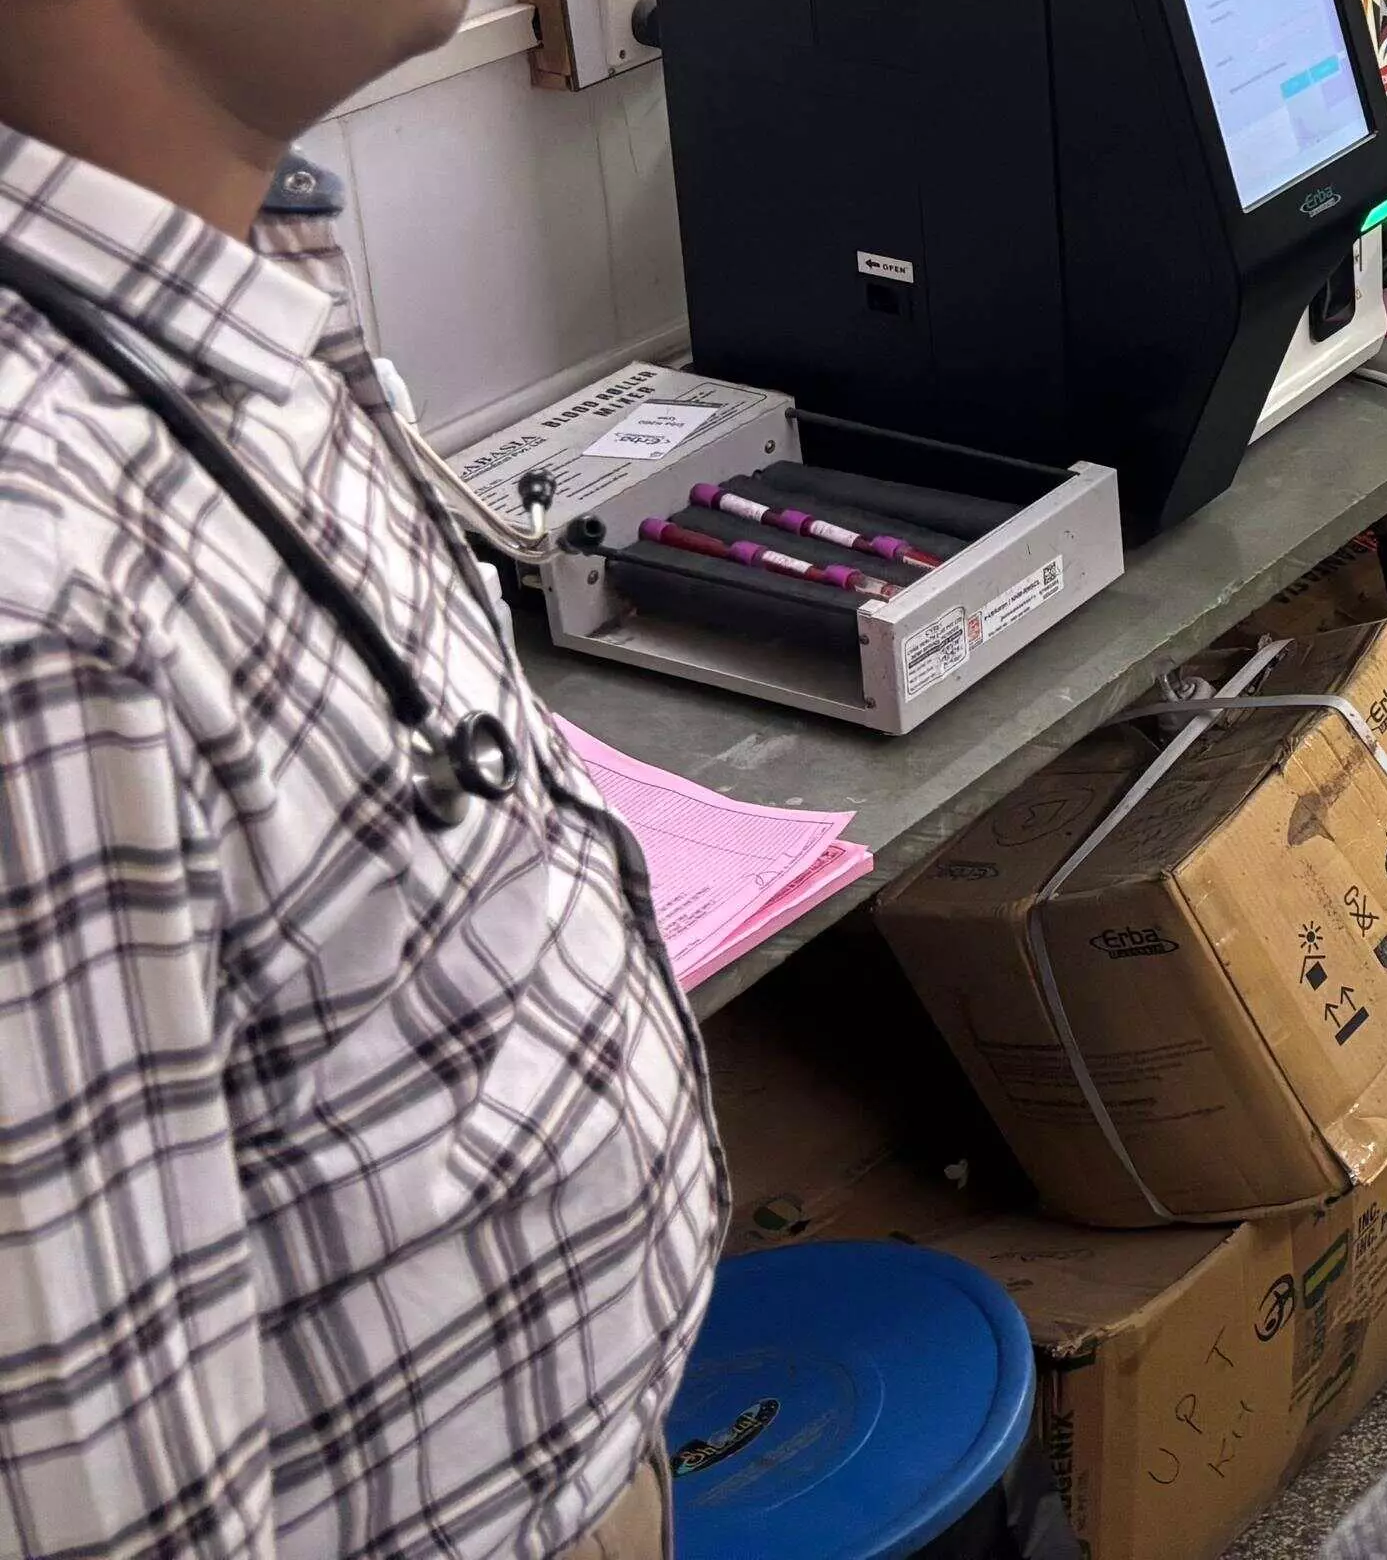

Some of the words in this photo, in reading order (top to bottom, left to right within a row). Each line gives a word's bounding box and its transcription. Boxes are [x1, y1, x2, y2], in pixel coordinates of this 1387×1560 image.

[882, 263, 906, 274] OPEN
[541, 400, 596, 428] BLOOD
[596, 370, 658, 401] ROLLER
[592, 386, 656, 419] MIXER
[1101, 926, 1158, 948] Erba
